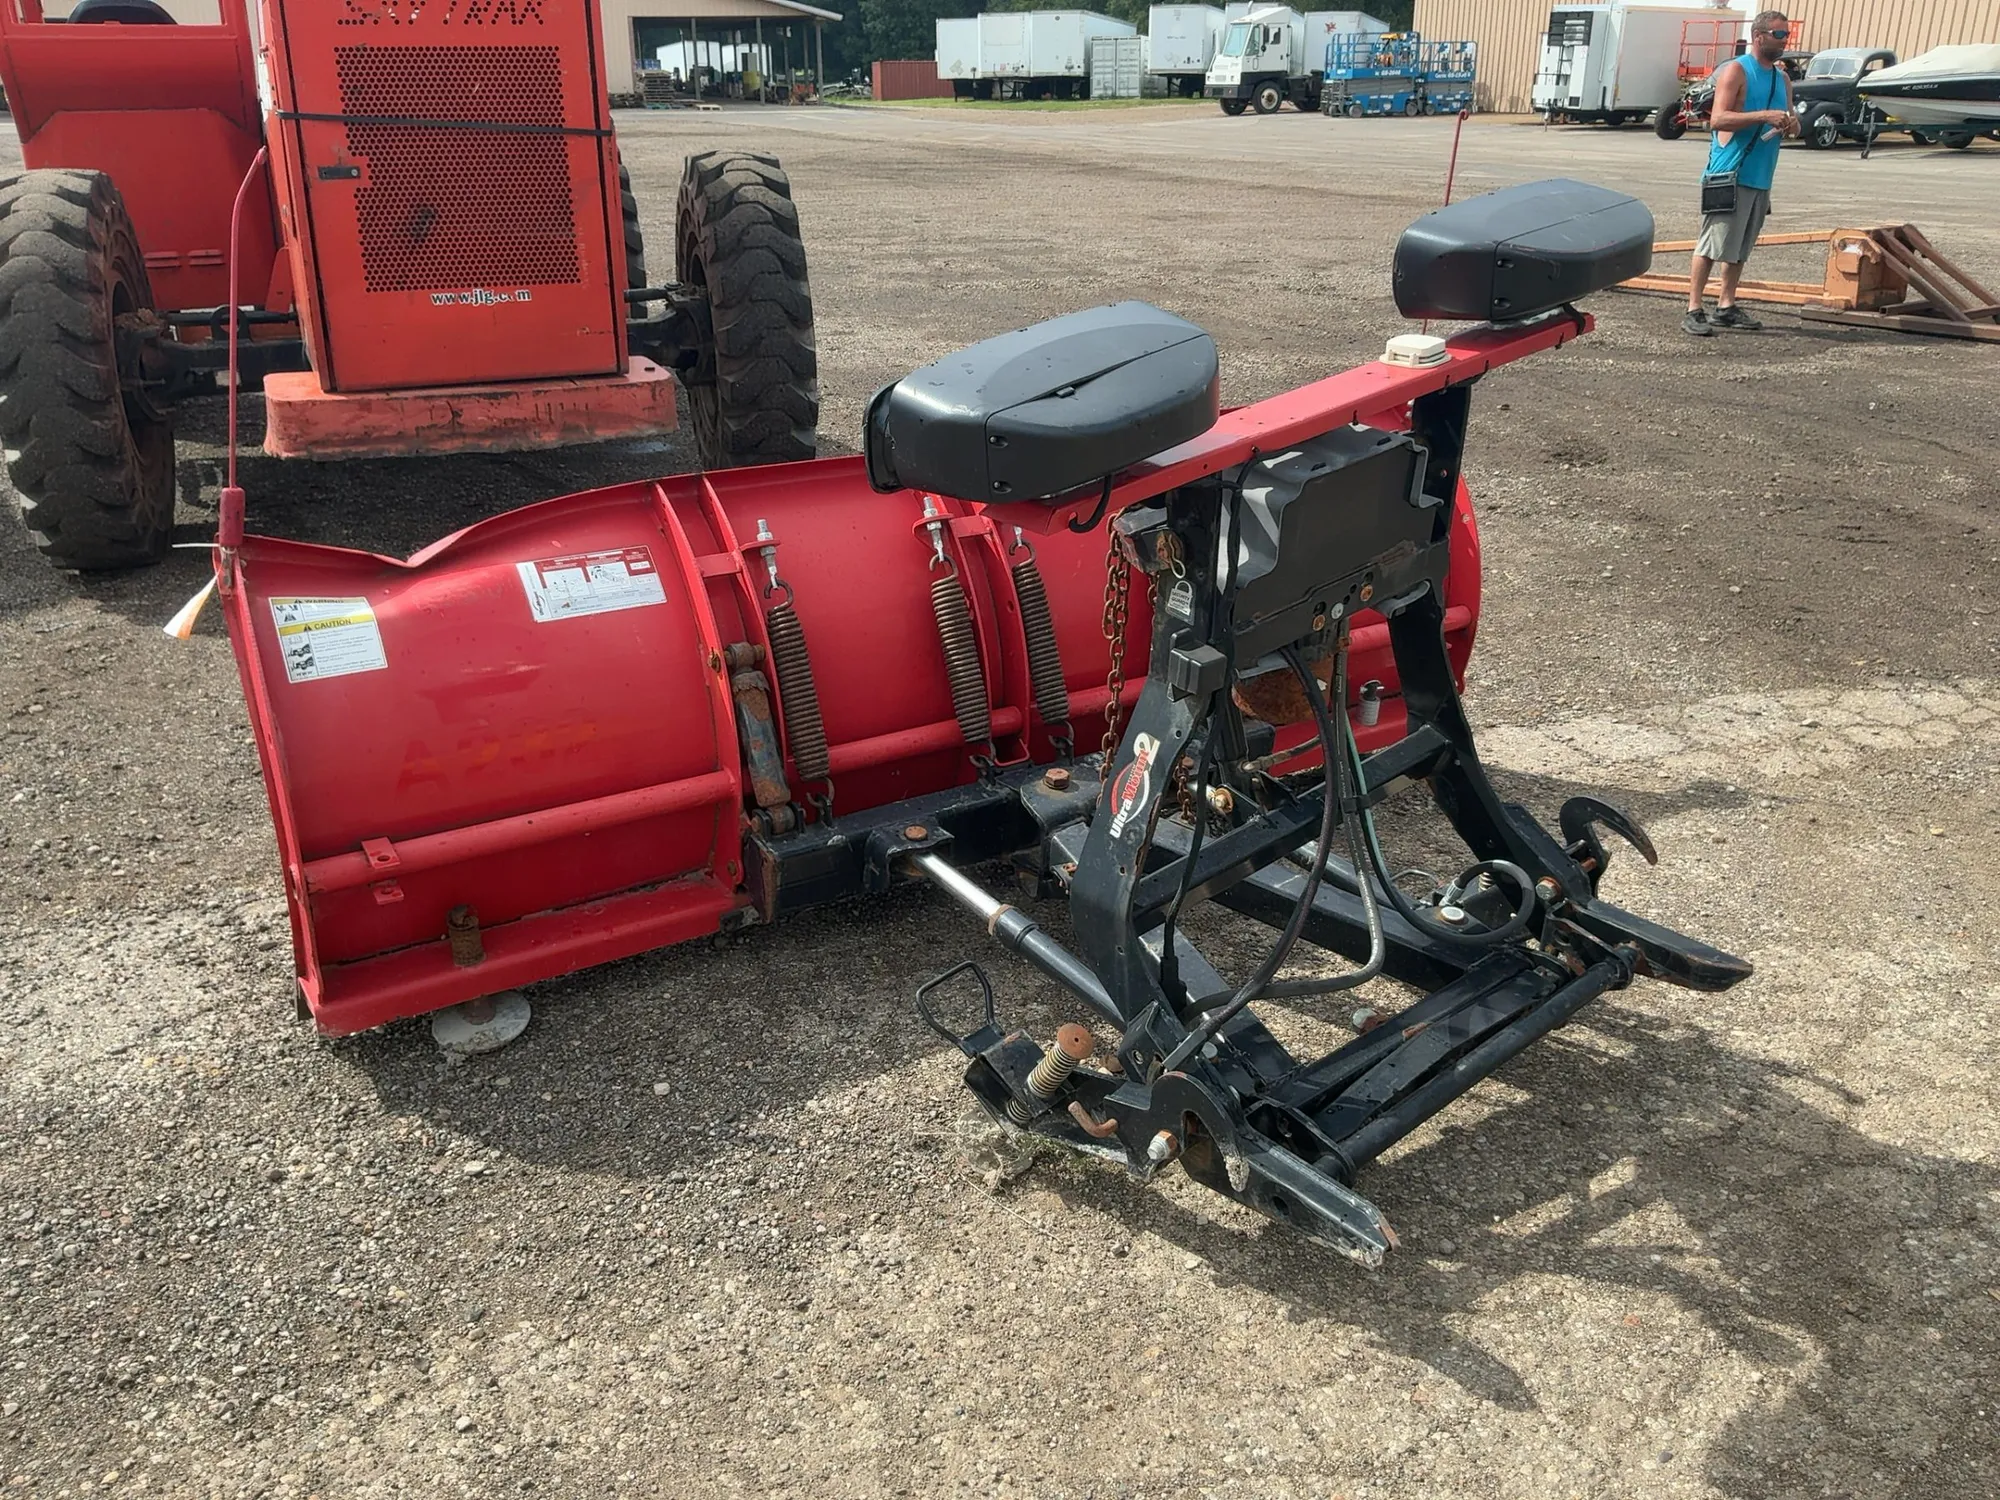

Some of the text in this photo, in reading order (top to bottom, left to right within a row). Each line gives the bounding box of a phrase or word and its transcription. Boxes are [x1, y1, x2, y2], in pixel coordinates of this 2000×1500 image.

[314, 618, 352, 630] CAUTION
[1109, 732, 1161, 839] UltraMount 2
